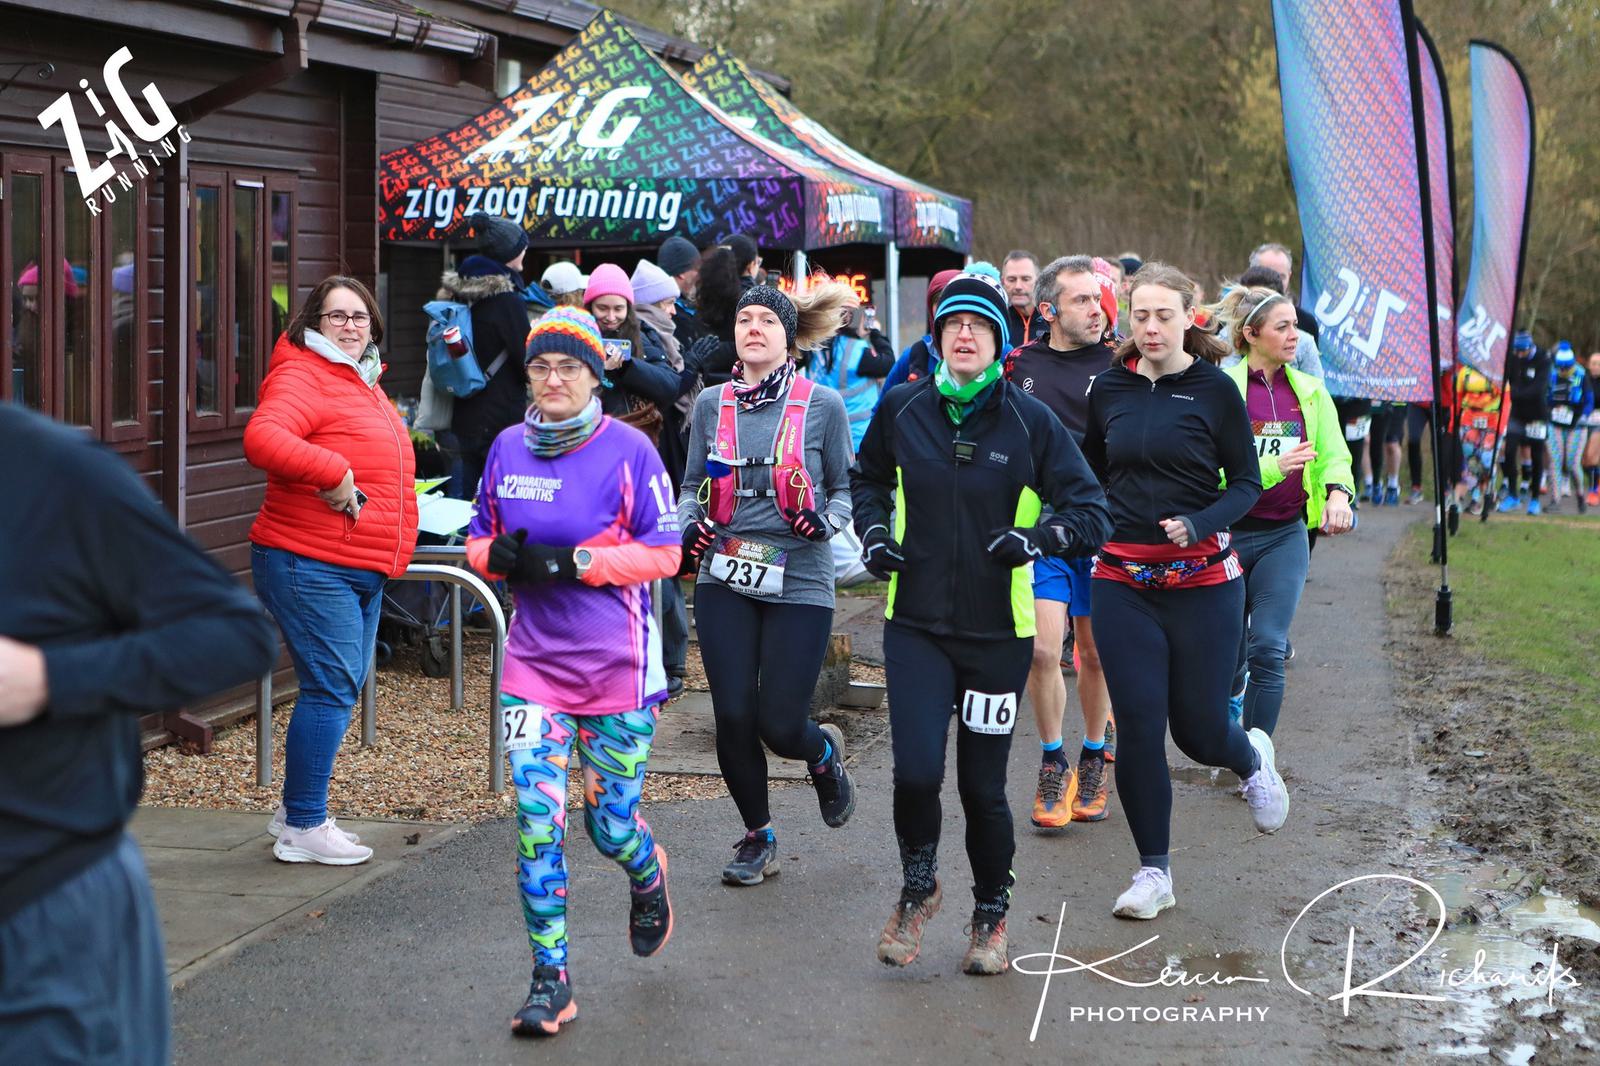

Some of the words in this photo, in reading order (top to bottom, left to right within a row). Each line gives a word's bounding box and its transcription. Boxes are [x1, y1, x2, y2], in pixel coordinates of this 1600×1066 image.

[403, 182, 456, 229] zig
[536, 182, 683, 231] running
[990, 451, 1009, 461] GORE
[503, 474, 517, 499] 12
[517, 475, 562, 490] MARATHONS
[516, 486, 554, 502] MONTHS
[648, 471, 677, 515] 12
[724, 559, 768, 589] 237
[966, 694, 1010, 725] 116
